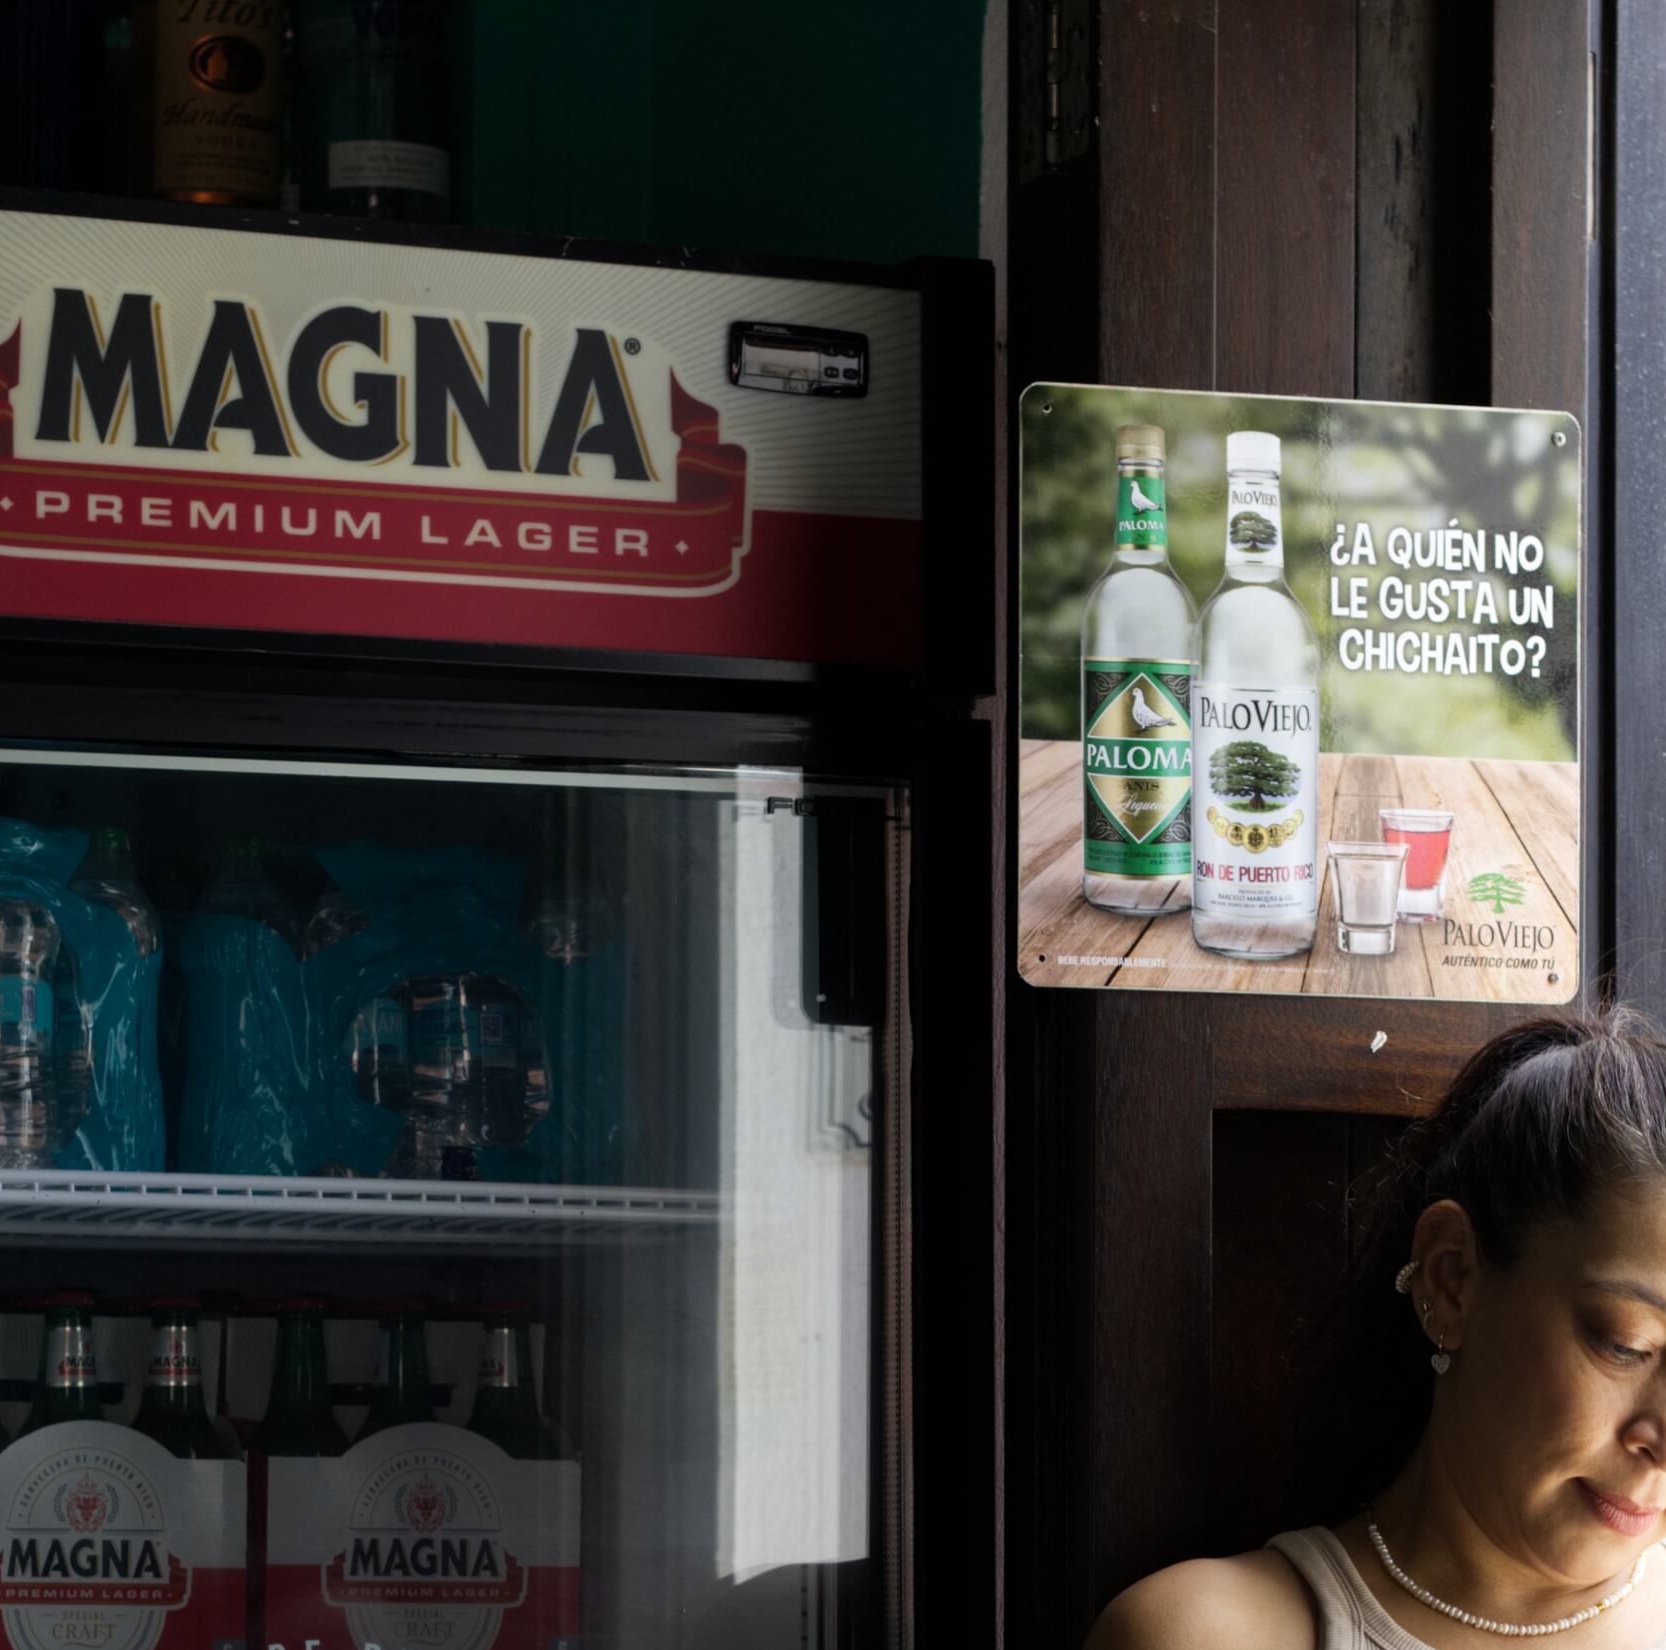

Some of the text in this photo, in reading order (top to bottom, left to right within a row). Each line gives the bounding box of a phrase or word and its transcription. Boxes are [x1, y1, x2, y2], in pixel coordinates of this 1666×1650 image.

[33, 286, 664, 483] MAGNA
[35, 489, 652, 559] PREMIUM LAGER
[1330, 518, 1544, 575] ¿A QUIÉN NO
[1330, 576, 1554, 629] LE GUSTA UN
[1339, 628, 1547, 678] CHICHAITO?
[1086, 743, 1192, 771] PALOMA
[1123, 781, 1160, 792] ANIS
[1197, 861, 1314, 883] RON DE PUERTO RICO
[1441, 953, 1556, 971] AUTÉNTICO COMO TÚ
[6, 1537, 162, 1579] MAGNA
[348, 1537, 501, 1578] MAGNA
[5, 1588, 164, 1600] PREMIUM LAGER
[347, 1587, 501, 1599] PREMIUM LAGER
[51, 1622, 118, 1643] CRAFT
